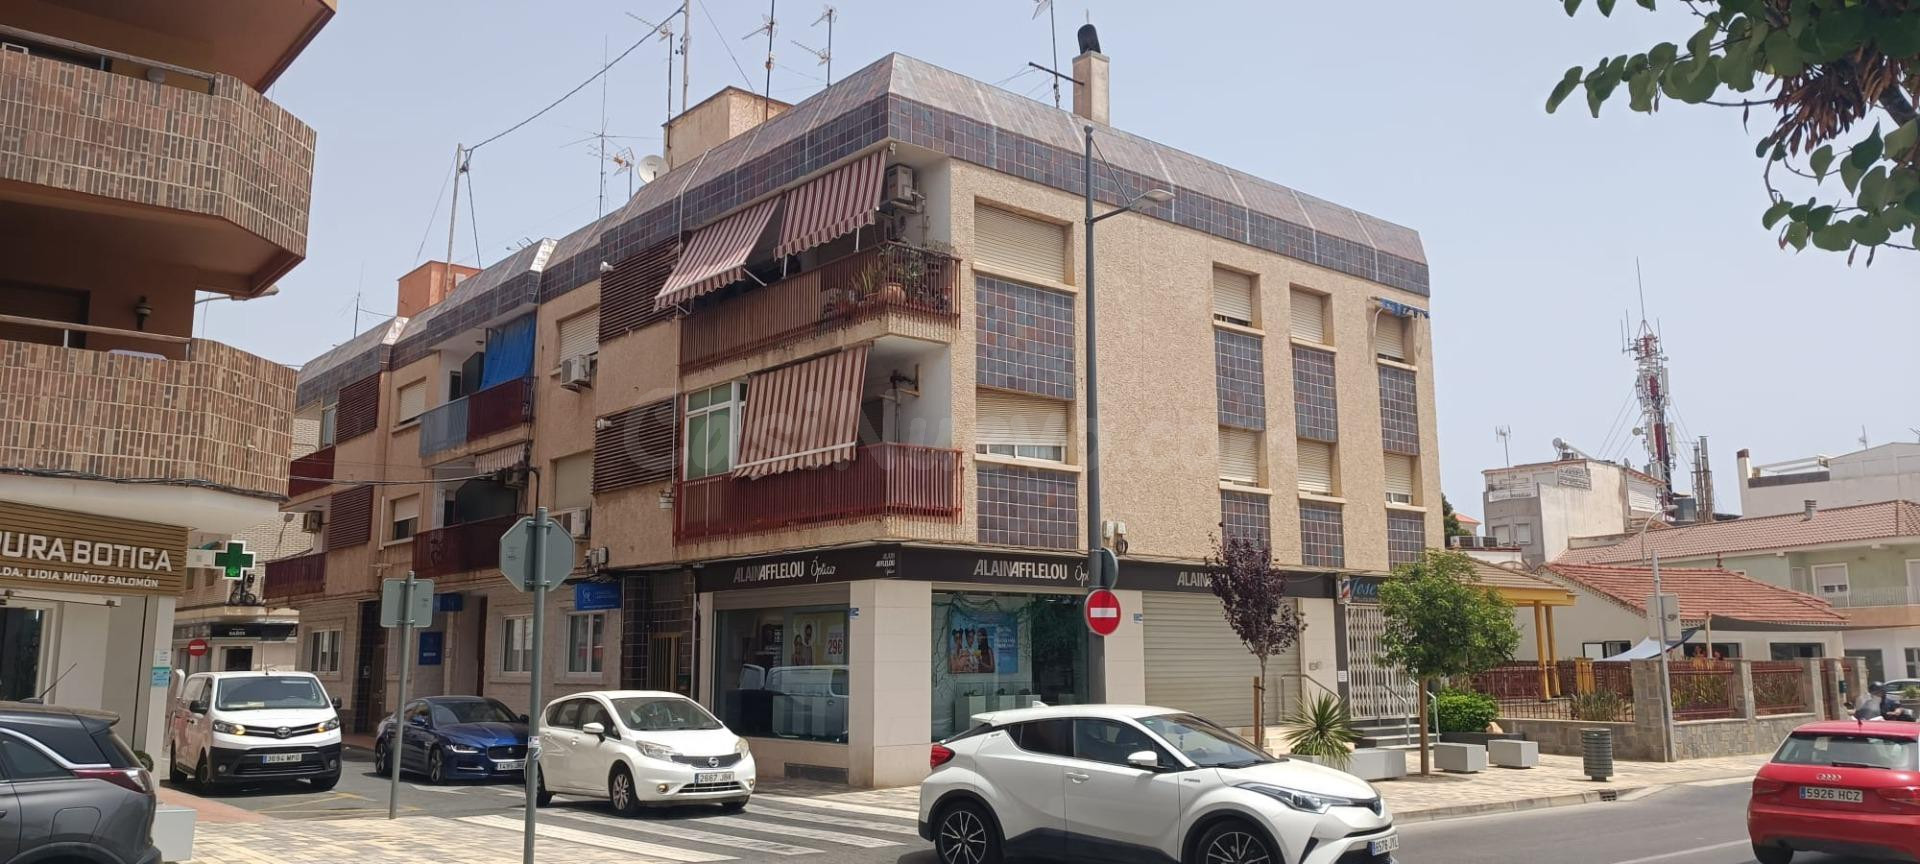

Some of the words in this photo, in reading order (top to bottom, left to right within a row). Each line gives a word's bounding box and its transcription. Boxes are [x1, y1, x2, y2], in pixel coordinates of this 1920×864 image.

[0, 531, 67, 562] URA
[72, 539, 172, 571] BOTICA
[27, 568, 60, 580] LIDIA
[64, 571, 105, 583] MUÑOZ
[107, 576, 159, 587] SALOMÓN
[1806, 788, 1834, 799] 5926
[1838, 790, 1861, 801] HCZ
